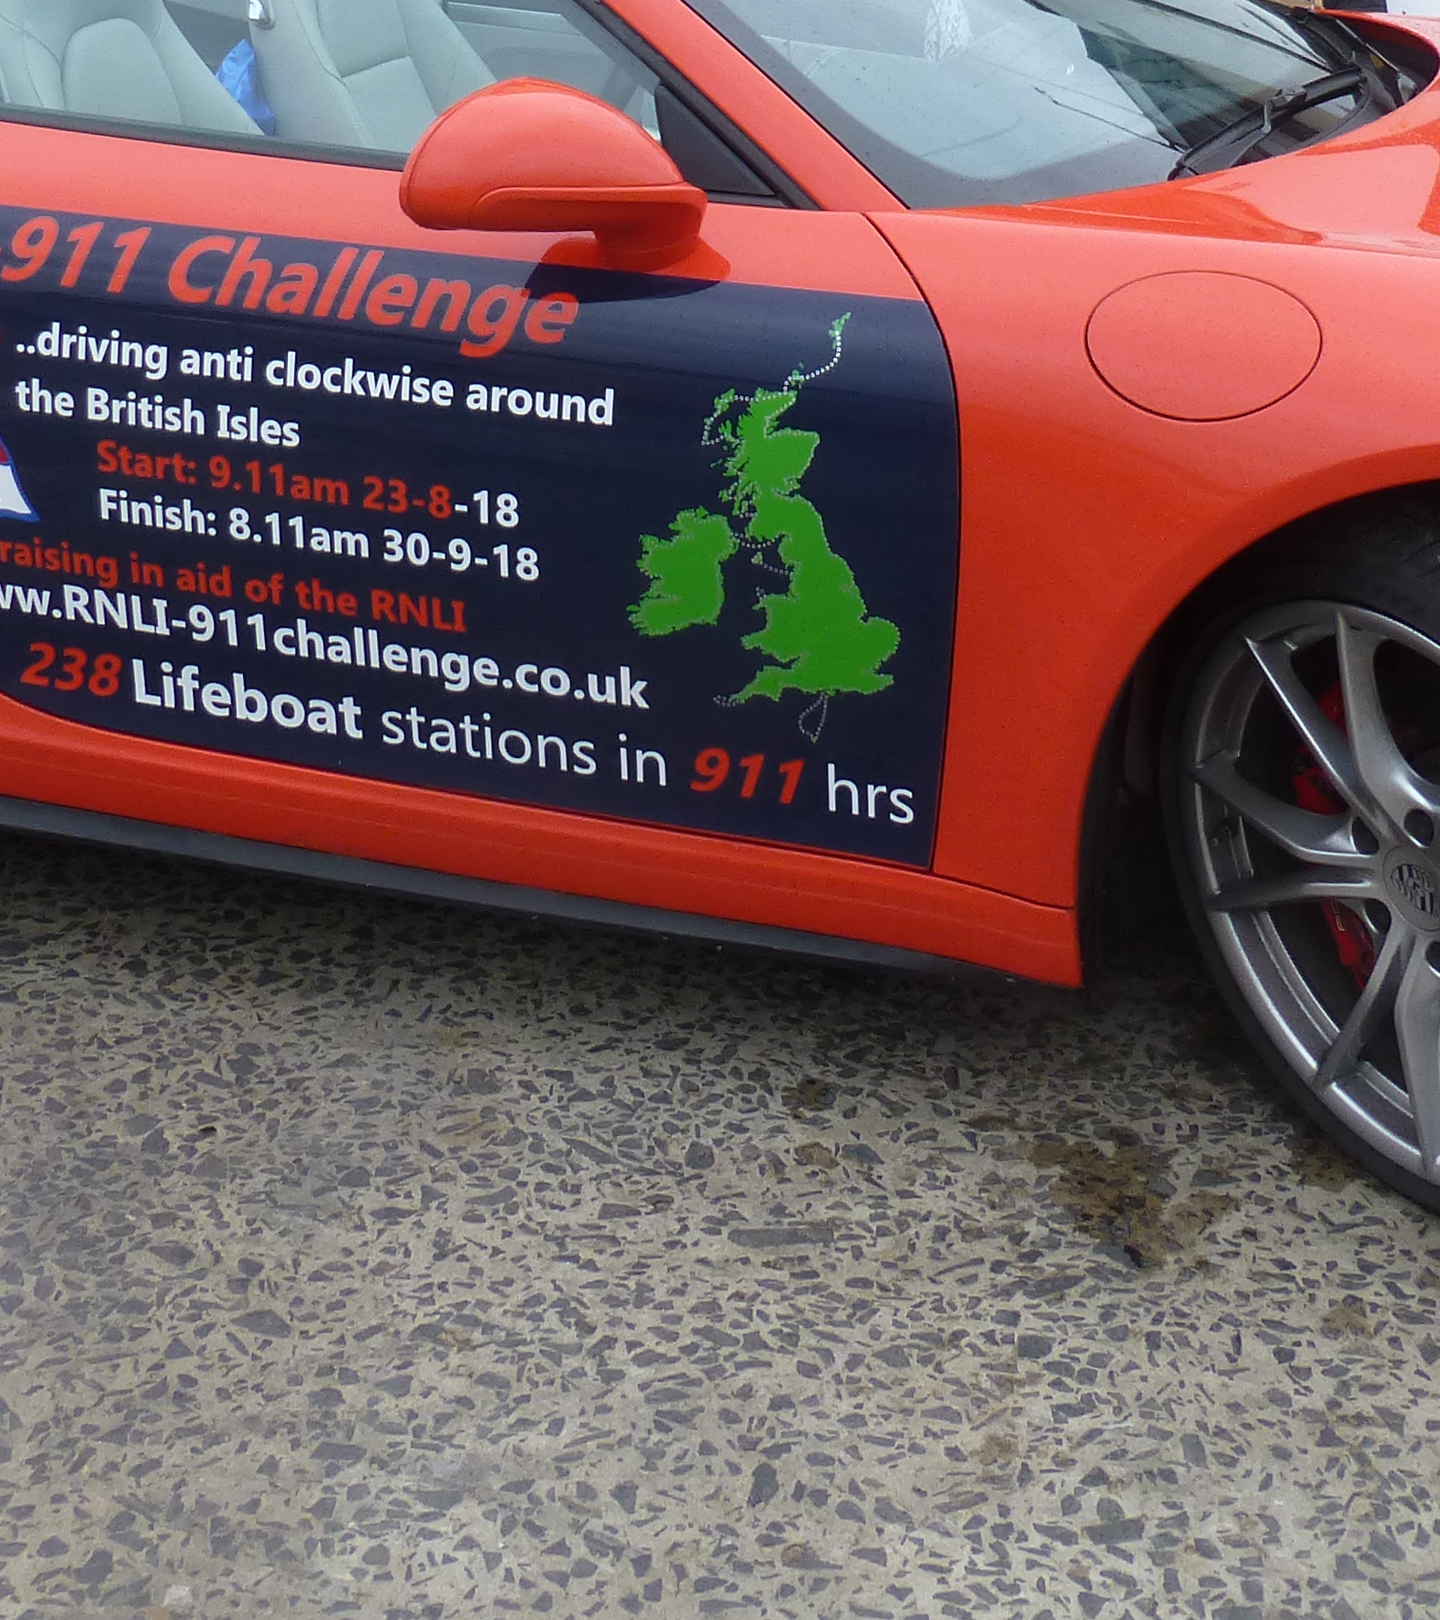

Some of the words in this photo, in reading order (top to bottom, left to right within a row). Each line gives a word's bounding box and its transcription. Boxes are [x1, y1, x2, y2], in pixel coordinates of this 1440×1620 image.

[168, 235, 581, 359] Challenge
[15, 379, 75, 418] the
[87, 387, 205, 436] British
[217, 404, 301, 448] Isles
[179, 346, 254, 382] anti
[265, 351, 455, 407] clockwise
[465, 388, 615, 426] around
[97, 439, 197, 485] Start:
[208, 455, 350, 506] 9.11am
[362, 476, 520, 529] 23-8-18
[99, 487, 217, 537] Finish:
[228, 507, 370, 559] 8.11am
[383, 528, 540, 581] 30-9-18
[131, 552, 164, 586] in
[176, 561, 233, 599] aid
[245, 573, 286, 604] of
[295, 581, 358, 617] the
[371, 588, 467, 633] RNLI
[20, 641, 123, 697] 238
[132, 658, 363, 740] Lifeboat
[381, 703, 598, 777] stations
[619, 733, 668, 787] in
[690, 747, 806, 805] 911
[826, 763, 915, 824] hrs
